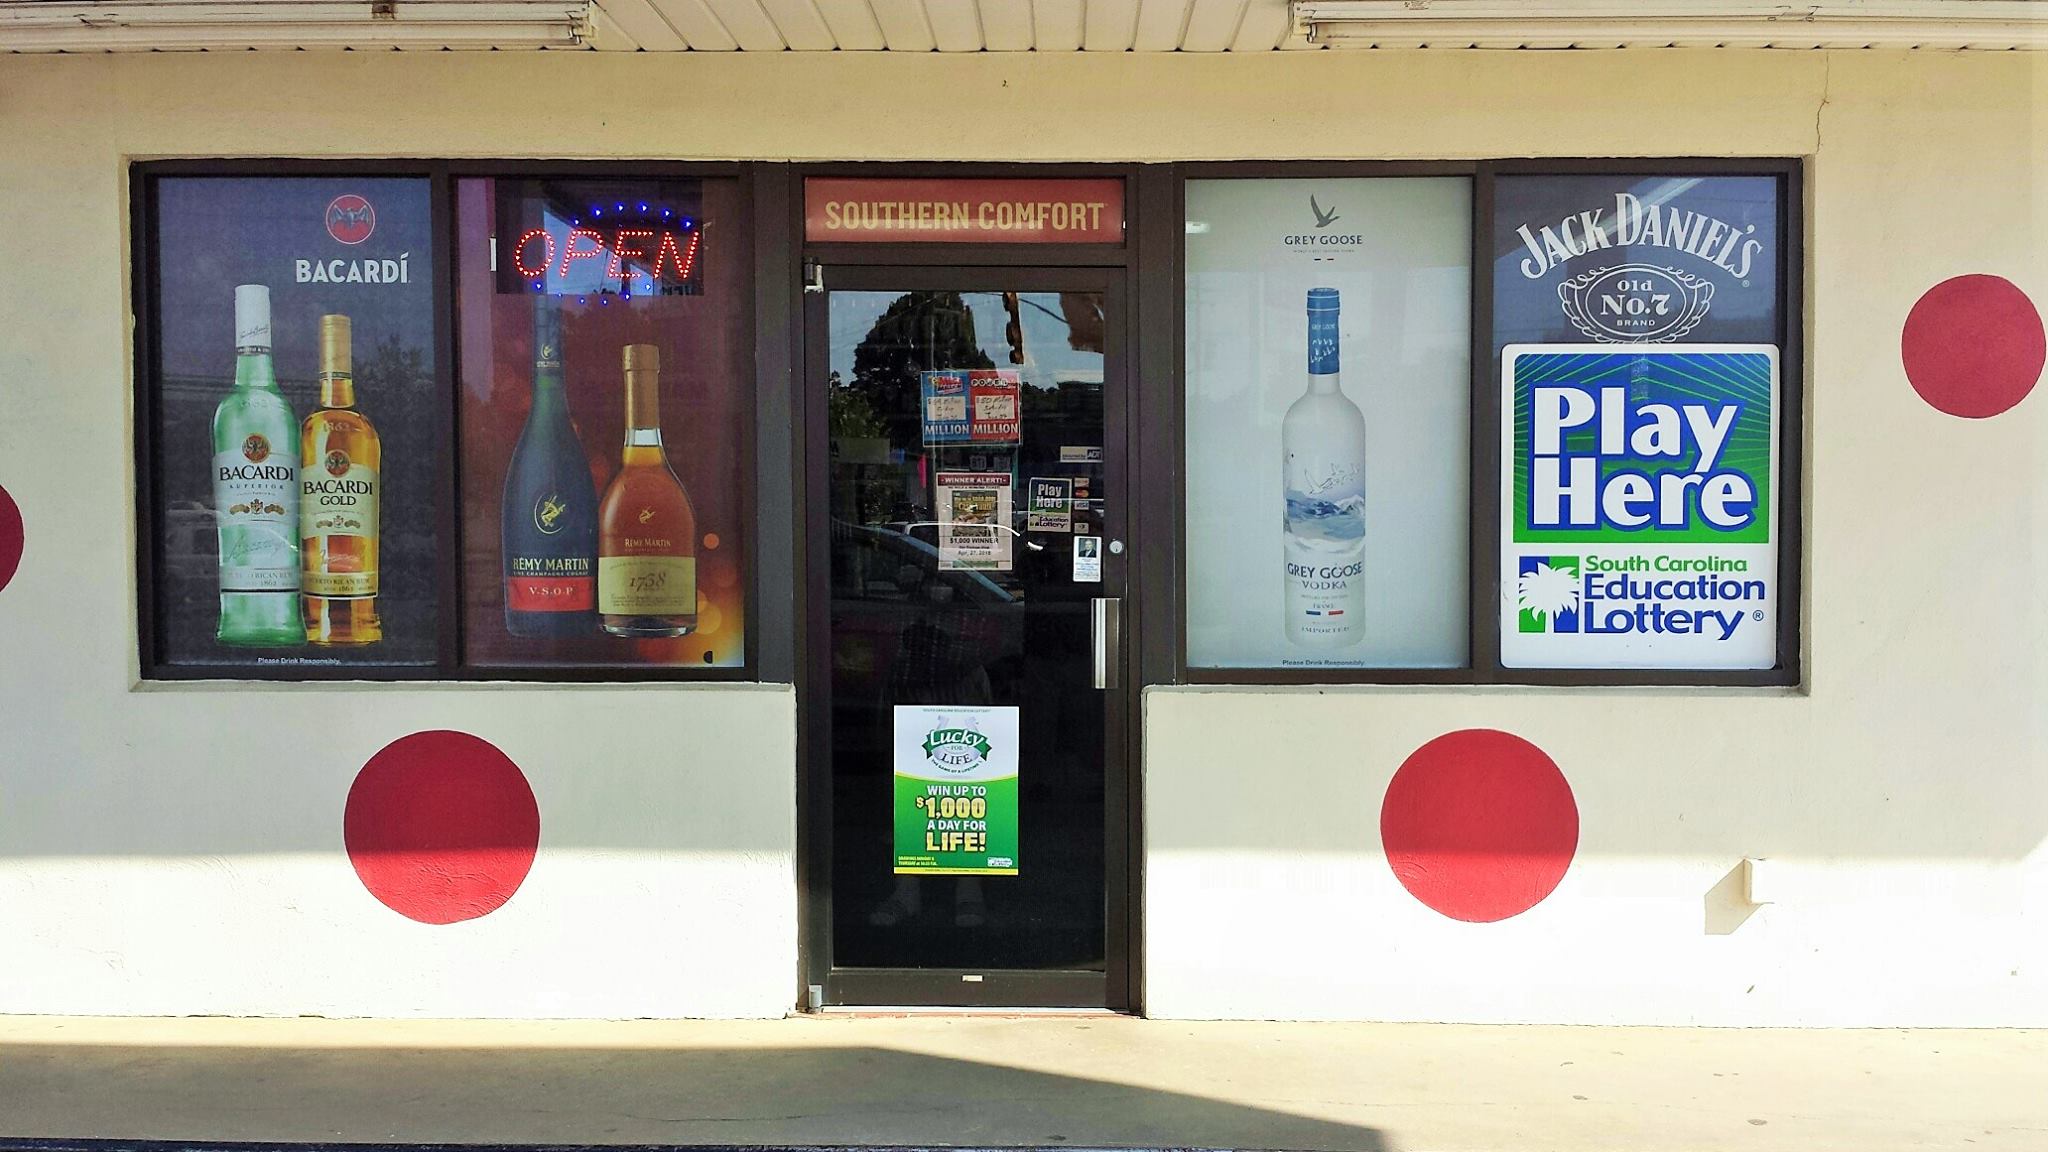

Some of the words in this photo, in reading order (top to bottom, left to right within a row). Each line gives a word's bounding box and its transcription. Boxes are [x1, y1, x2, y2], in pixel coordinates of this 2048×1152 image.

[824, 200, 970, 230] SOUTHERN
[978, 201, 1105, 231] COMFORT
[1284, 235, 1316, 245] GREY
[1320, 235, 1363, 245] GOOSE
[1515, 208, 1613, 279] JACK
[1614, 193, 1764, 279] DANIEL'S
[514, 228, 701, 279] OPEN
[296, 251, 410, 284] BACARDÍ
[1617, 280, 1653, 292] Old
[1616, 319, 1656, 327] BRAND
[925, 424, 969, 435] MILLION
[973, 424, 1017, 434] MILLION
[1534, 387, 1738, 472] Play
[219, 465, 294, 482] BACARDI
[303, 480, 373, 495] BACARDI
[1037, 483, 1062, 497] Play
[1533, 457, 1752, 526] Here
[320, 496, 357, 506] GOLD
[1036, 496, 1063, 508] Here
[545, 558, 589, 571] MARTIN
[1288, 562, 1315, 578] GREY
[1320, 562, 1362, 579] GOOSE
[1585, 555, 1650, 572] South
[1654, 555, 1747, 572] Carolina
[1302, 581, 1347, 590] VODKA
[1584, 573, 1766, 600] Education
[1584, 601, 1745, 641] Lottery
[930, 729, 984, 747] Lucky
[940, 753, 972, 765] LIFE
[927, 785, 951, 796] WIN
[953, 785, 968, 796] UP
[971, 786, 987, 796] TO
[916, 797, 986, 819] $1,000
[927, 820, 935, 830] A
[938, 820, 961, 830] DAY
[963, 820, 986, 830] FOR
[926, 832, 986, 851] LIFE!
